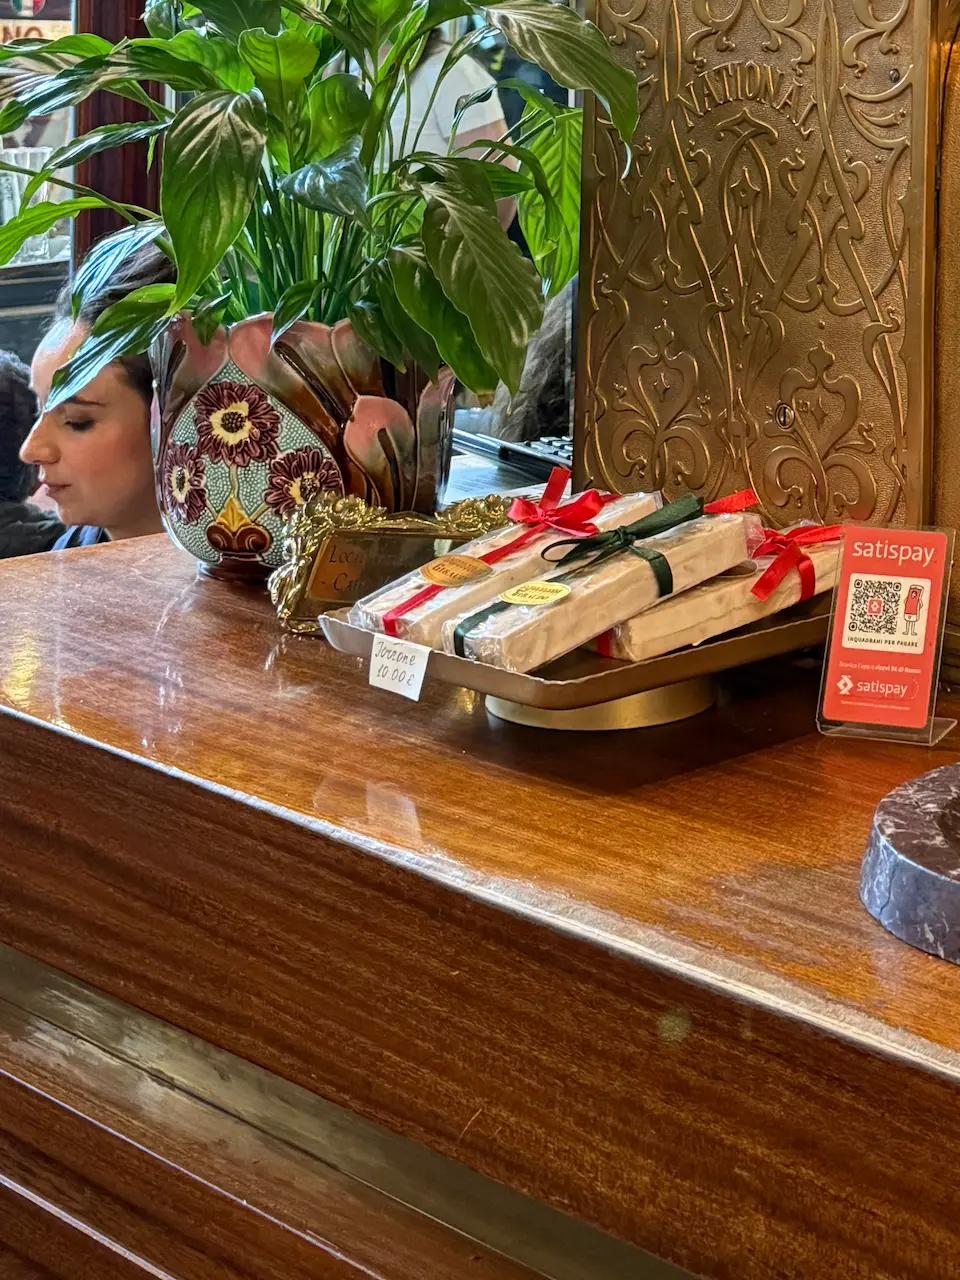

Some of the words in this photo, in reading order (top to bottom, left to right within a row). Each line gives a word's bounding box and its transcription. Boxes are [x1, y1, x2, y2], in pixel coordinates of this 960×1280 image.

[677, 60, 817, 139] NATIONAL
[852, 540, 935, 568] satispay
[848, 635, 882, 645] INQUADRAMI
[884, 638, 896, 646] PER
[897, 640, 919, 648] PAGARE
[857, 680, 908, 698] satispay
